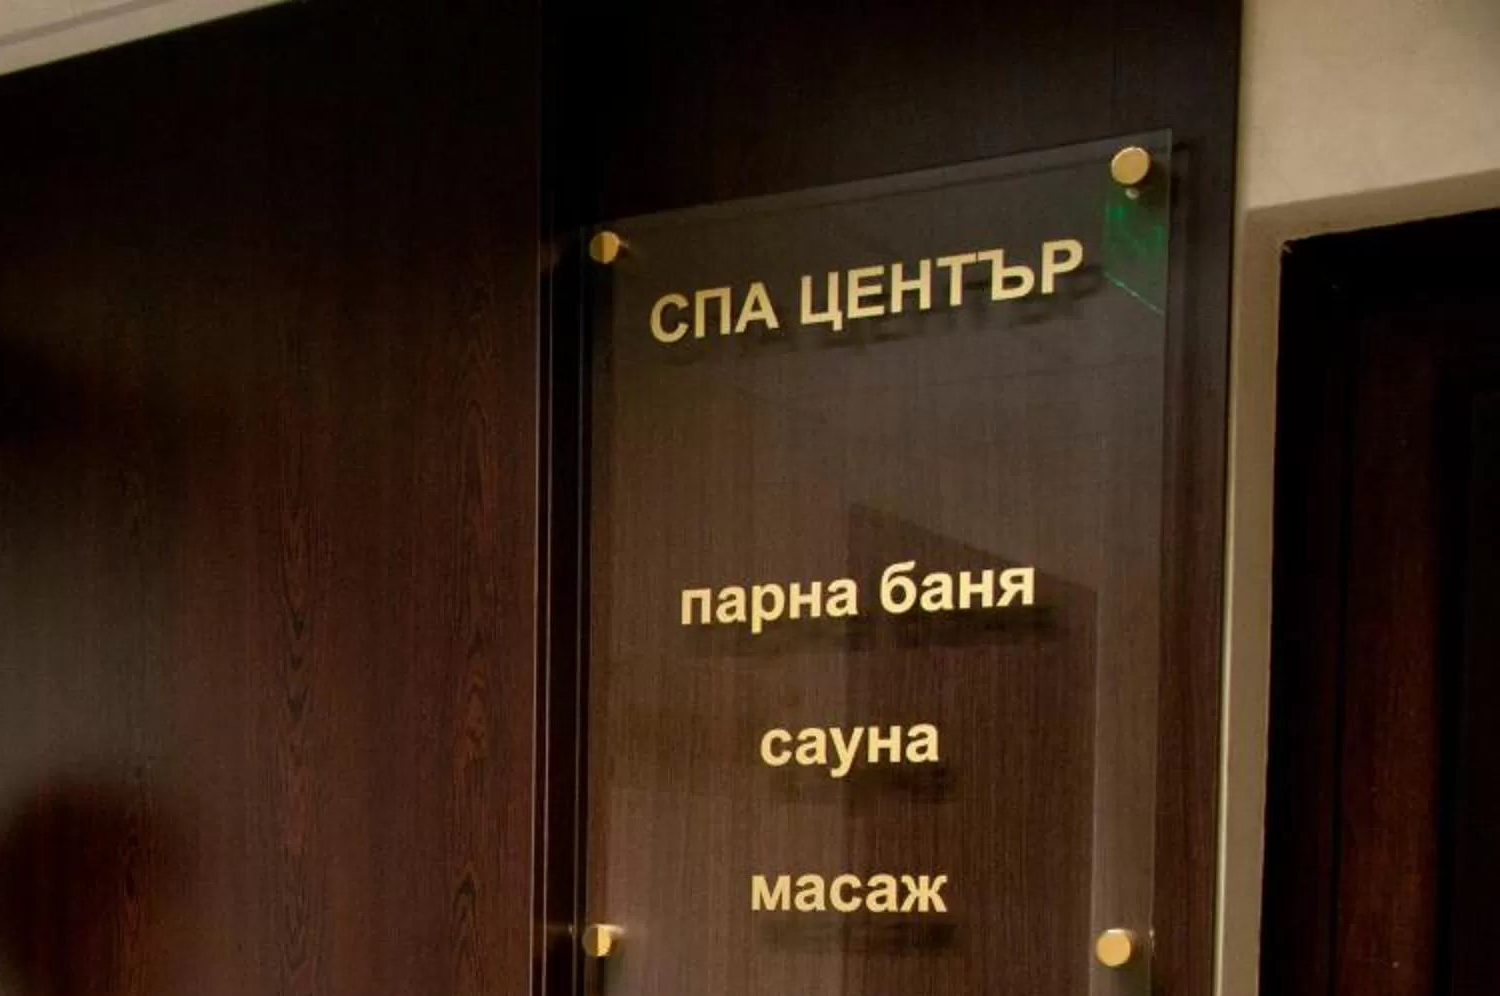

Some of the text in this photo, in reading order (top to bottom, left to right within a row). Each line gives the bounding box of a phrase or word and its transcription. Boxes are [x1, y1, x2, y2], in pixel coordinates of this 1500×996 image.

[650, 239, 1083, 343] СПА ЦЕНТЪР
[681, 559, 1036, 635] парна баня
[759, 723, 939, 779] сауна
[751, 873, 949, 913] масаж
